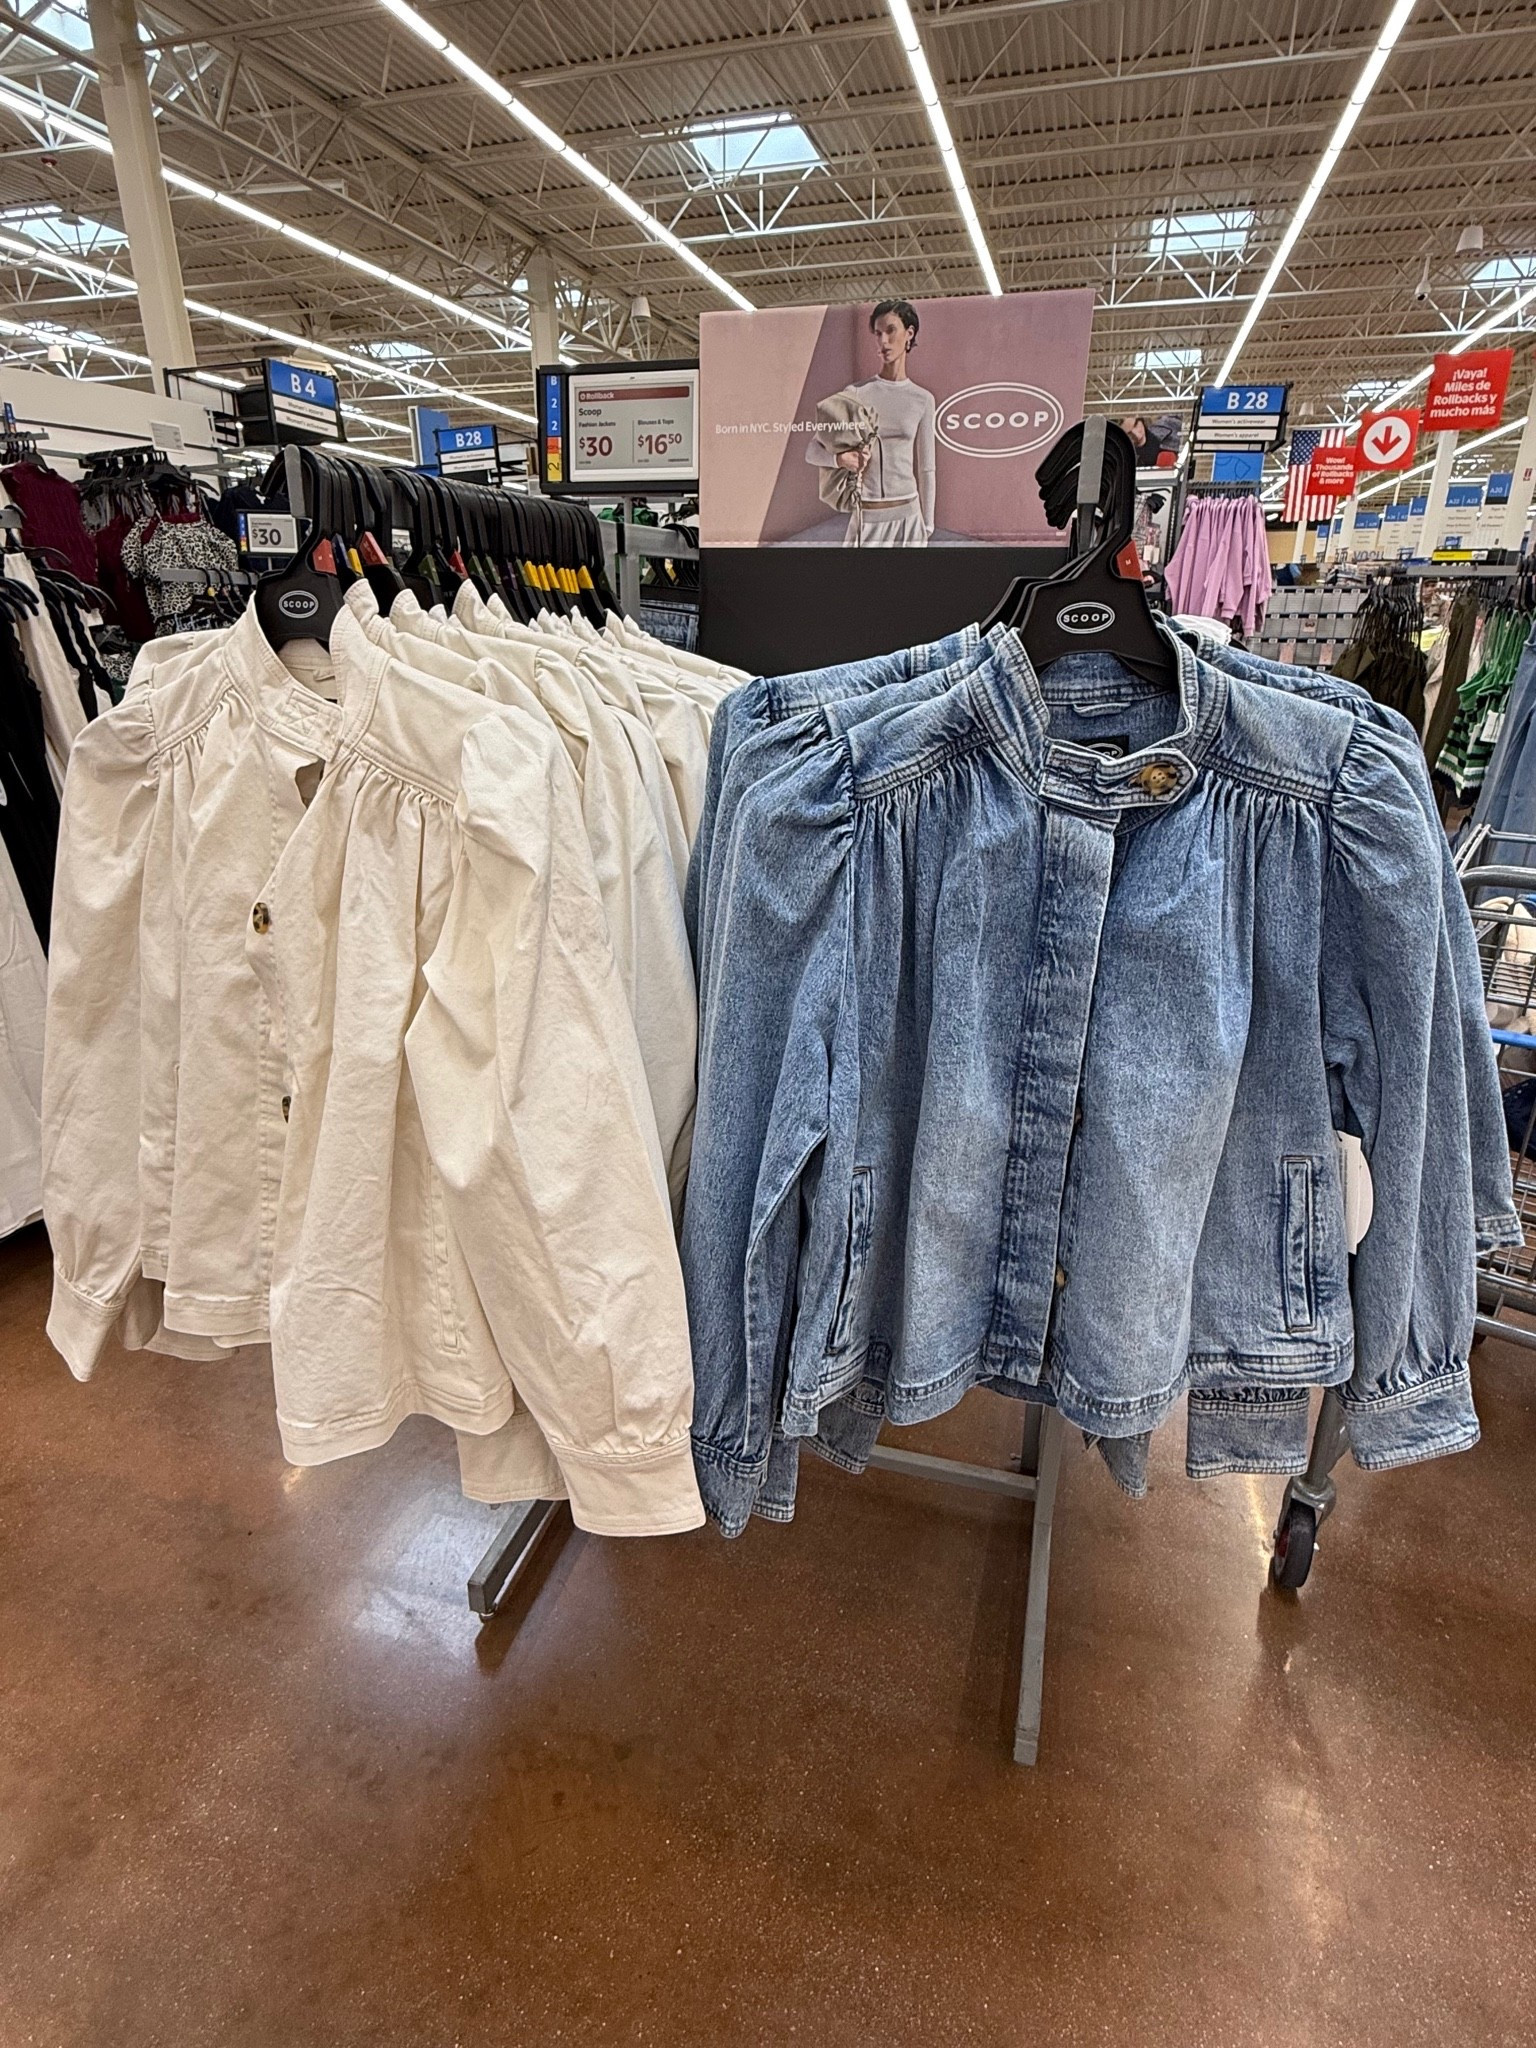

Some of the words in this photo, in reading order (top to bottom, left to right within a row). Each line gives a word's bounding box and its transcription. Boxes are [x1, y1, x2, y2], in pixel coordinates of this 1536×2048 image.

[1453, 368, 1488, 381] ¡Vaya!
[290, 373, 302, 393] B
[305, 378, 316, 398] 4
[1444, 382, 1474, 393] Miles
[1475, 380, 1491, 390] de
[586, 392, 615, 400] Rollback
[1226, 392, 1240, 410] B
[1243, 391, 1269, 410] 28
[1433, 394, 1488, 406] Rollbacks
[1489, 394, 1498, 404] y
[578, 407, 602, 417] Scoop
[1430, 407, 1470, 418] mucho
[1471, 405, 1496, 416] más
[715, 424, 738, 434] Born
[739, 423, 749, 433] in
[750, 422, 772, 433] NYC.
[773, 421, 803, 434] Styled
[805, 419, 867, 432] Everywhere.
[946, 411, 1049, 430] SCOOP
[579, 435, 613, 457] $30
[252, 528, 282, 546] $30
[283, 600, 315, 609] SCOOP
[1062, 613, 1109, 623] SCOOP
